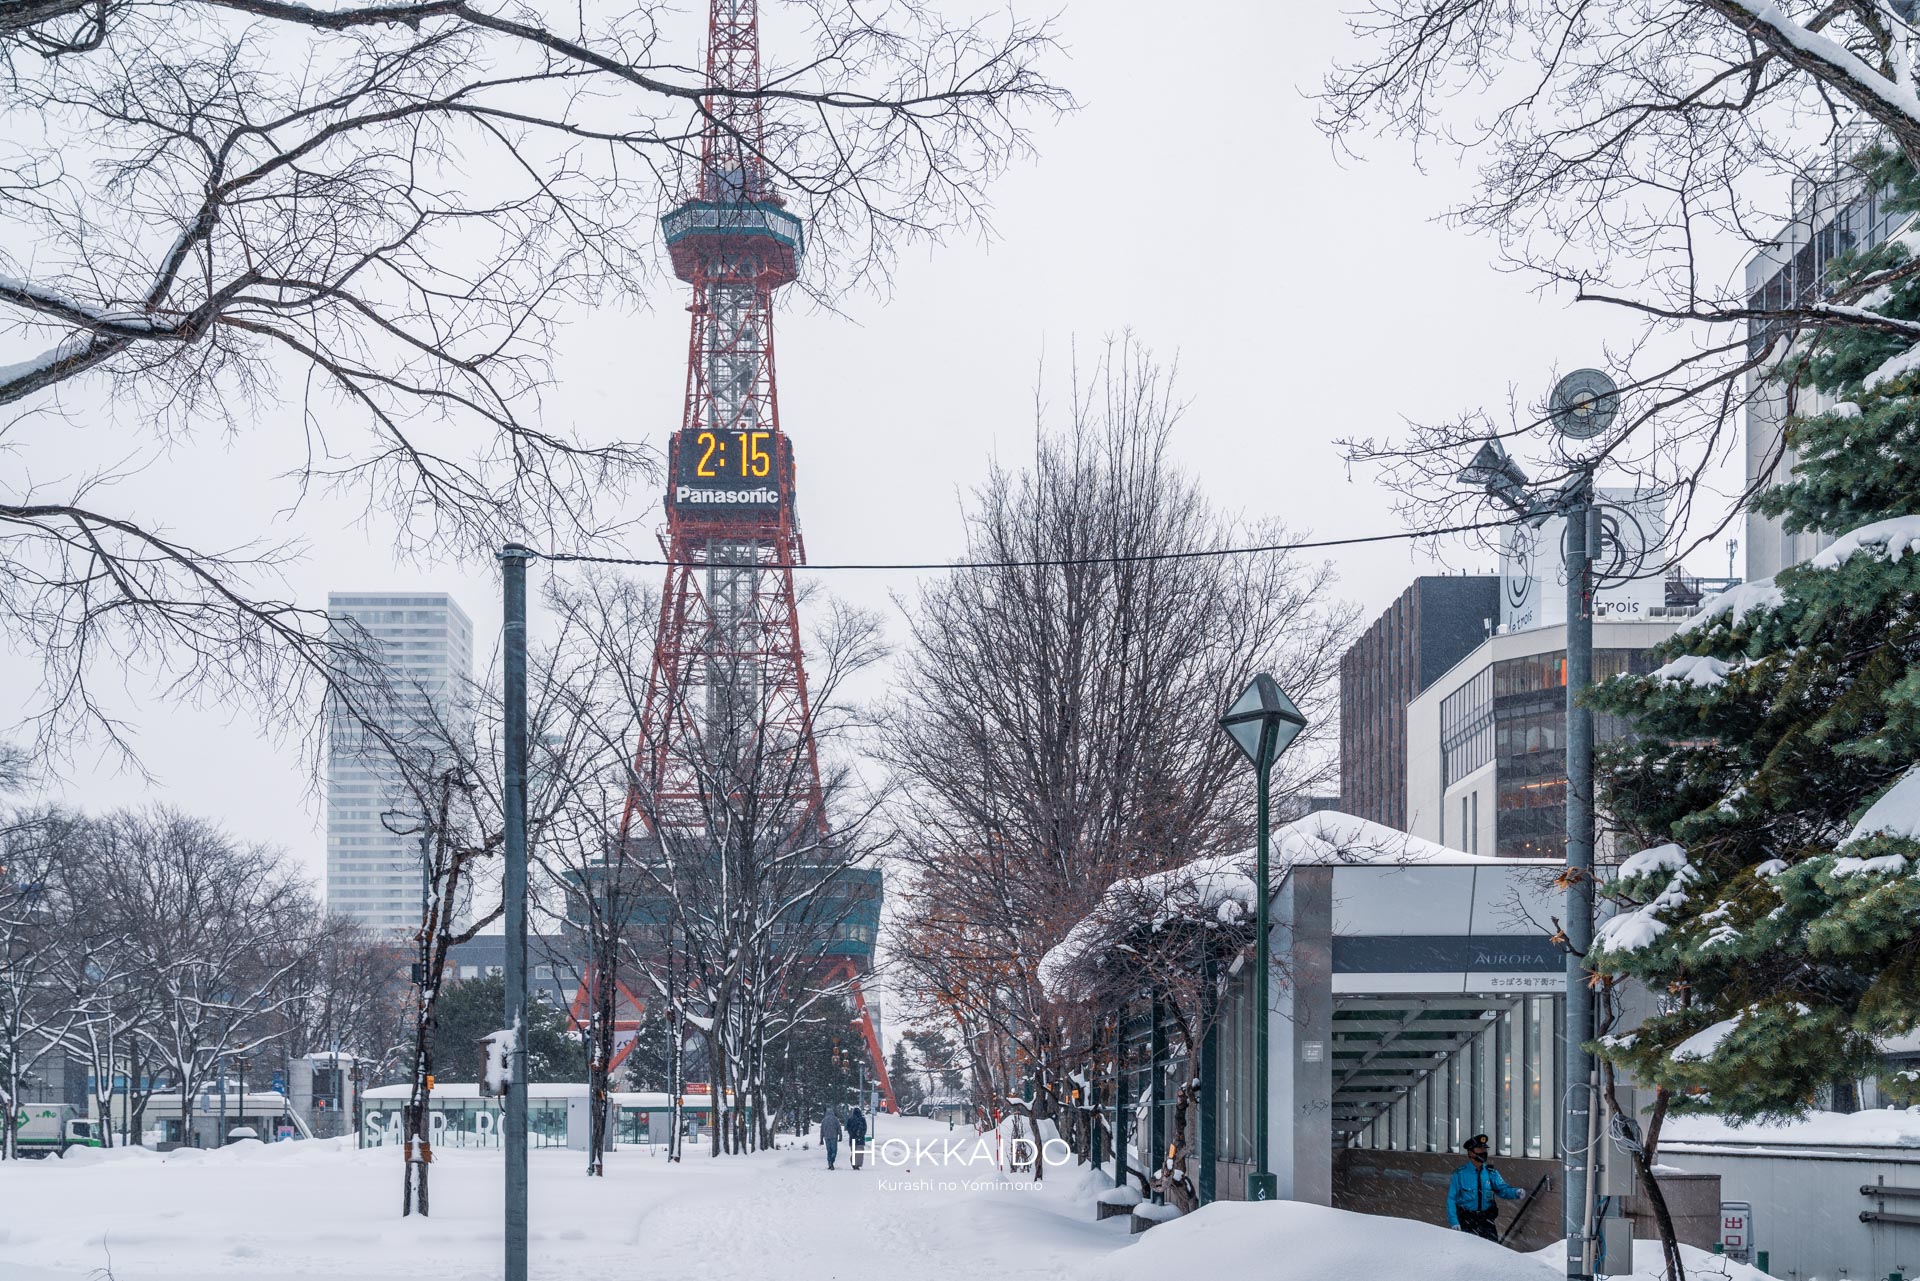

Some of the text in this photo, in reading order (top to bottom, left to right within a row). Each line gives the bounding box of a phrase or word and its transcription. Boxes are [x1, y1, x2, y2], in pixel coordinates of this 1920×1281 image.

[697, 432, 770, 477] 2:15
[676, 486, 779, 504] Panasonic
[1516, 607, 1533, 631] trois
[1474, 952, 1545, 965] AURORA
[1490, 977, 1566, 987] さっぽろ地下街オー
[1725, 1216, 1743, 1246] 出口
